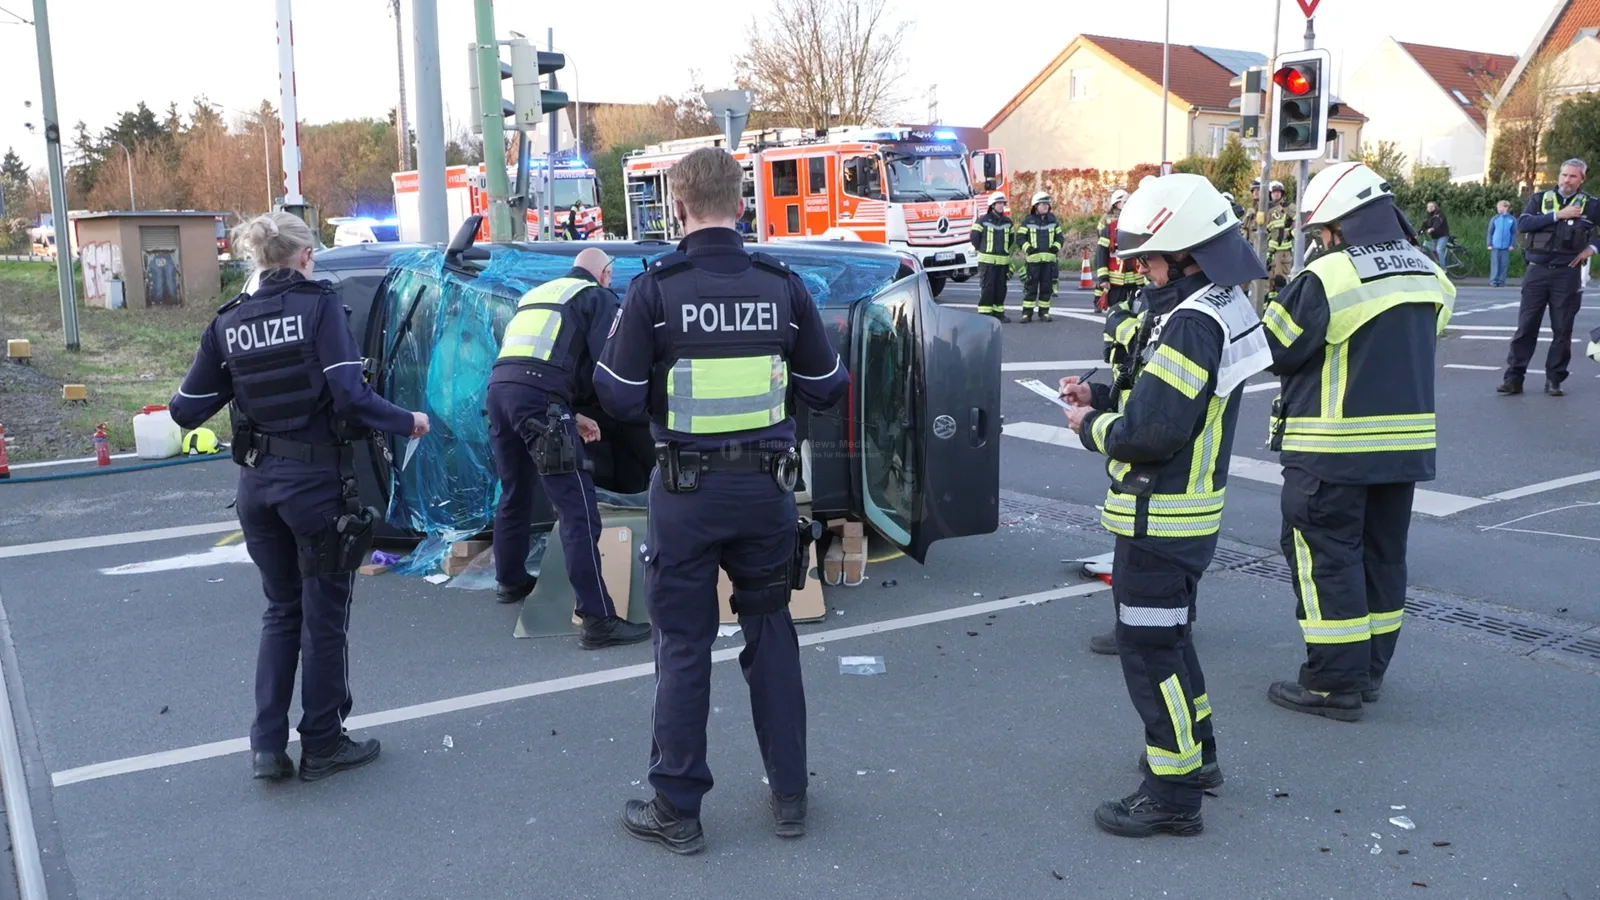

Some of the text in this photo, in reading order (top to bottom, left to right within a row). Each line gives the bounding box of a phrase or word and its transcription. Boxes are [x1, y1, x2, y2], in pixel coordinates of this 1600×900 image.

[922, 207, 962, 217] FEUERWEHR
[1373, 254, 1429, 271] B-Dien
[681, 302, 778, 333] POLIZEI
[225, 315, 304, 354] POLIZEI
